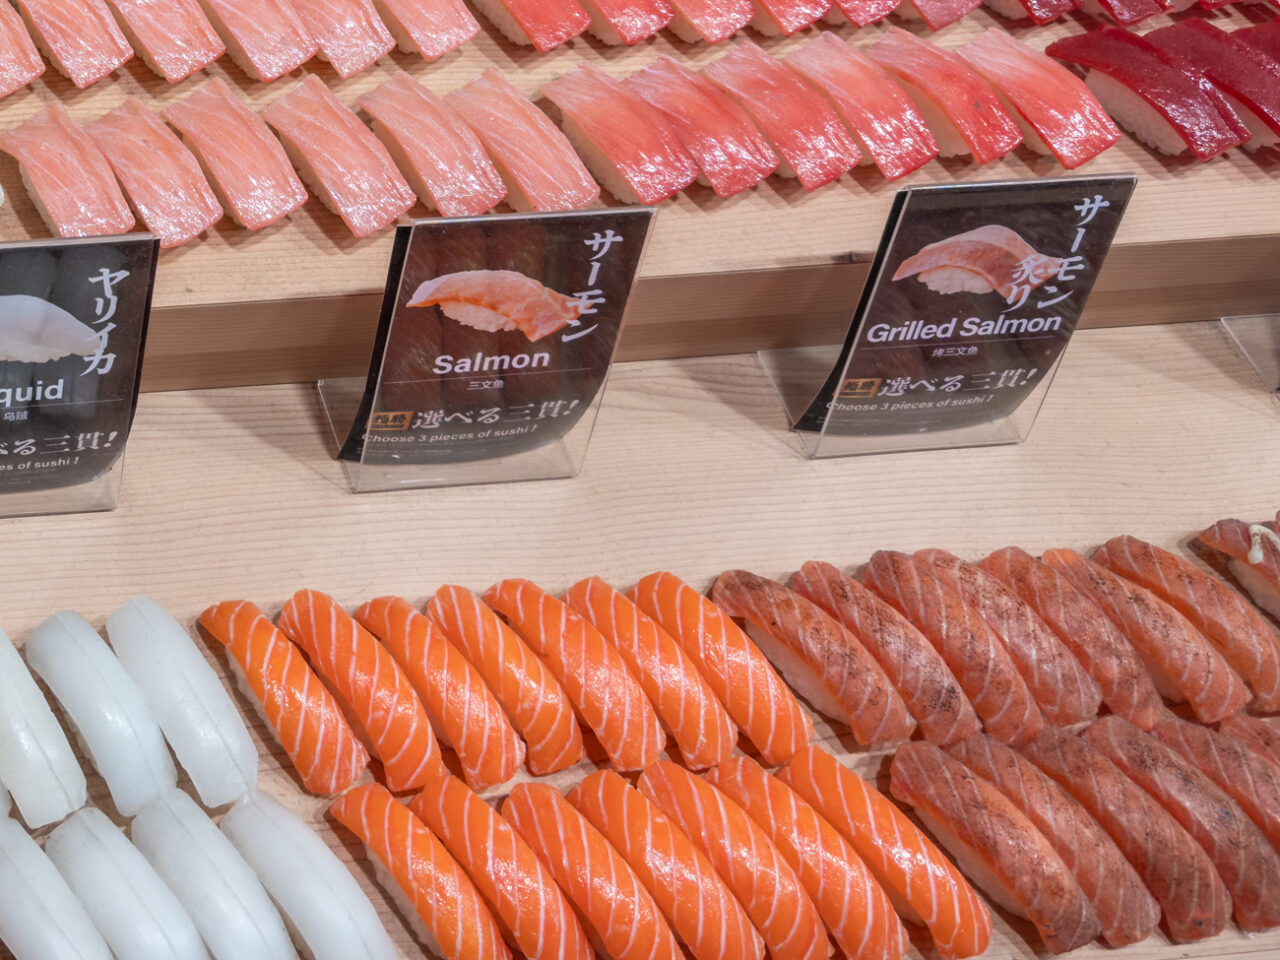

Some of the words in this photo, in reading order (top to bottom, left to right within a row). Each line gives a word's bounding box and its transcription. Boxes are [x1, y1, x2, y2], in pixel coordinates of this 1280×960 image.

[561, 228, 623, 343] サーモン
[1000, 253, 1050, 314] 炙り
[1036, 194, 1110, 310] サーモン
[79, 268, 130, 377] ヤリイカ
[432, 351, 550, 375] Salmon
[866, 318, 958, 343] Grilled
[959, 315, 1062, 339] Salmon
